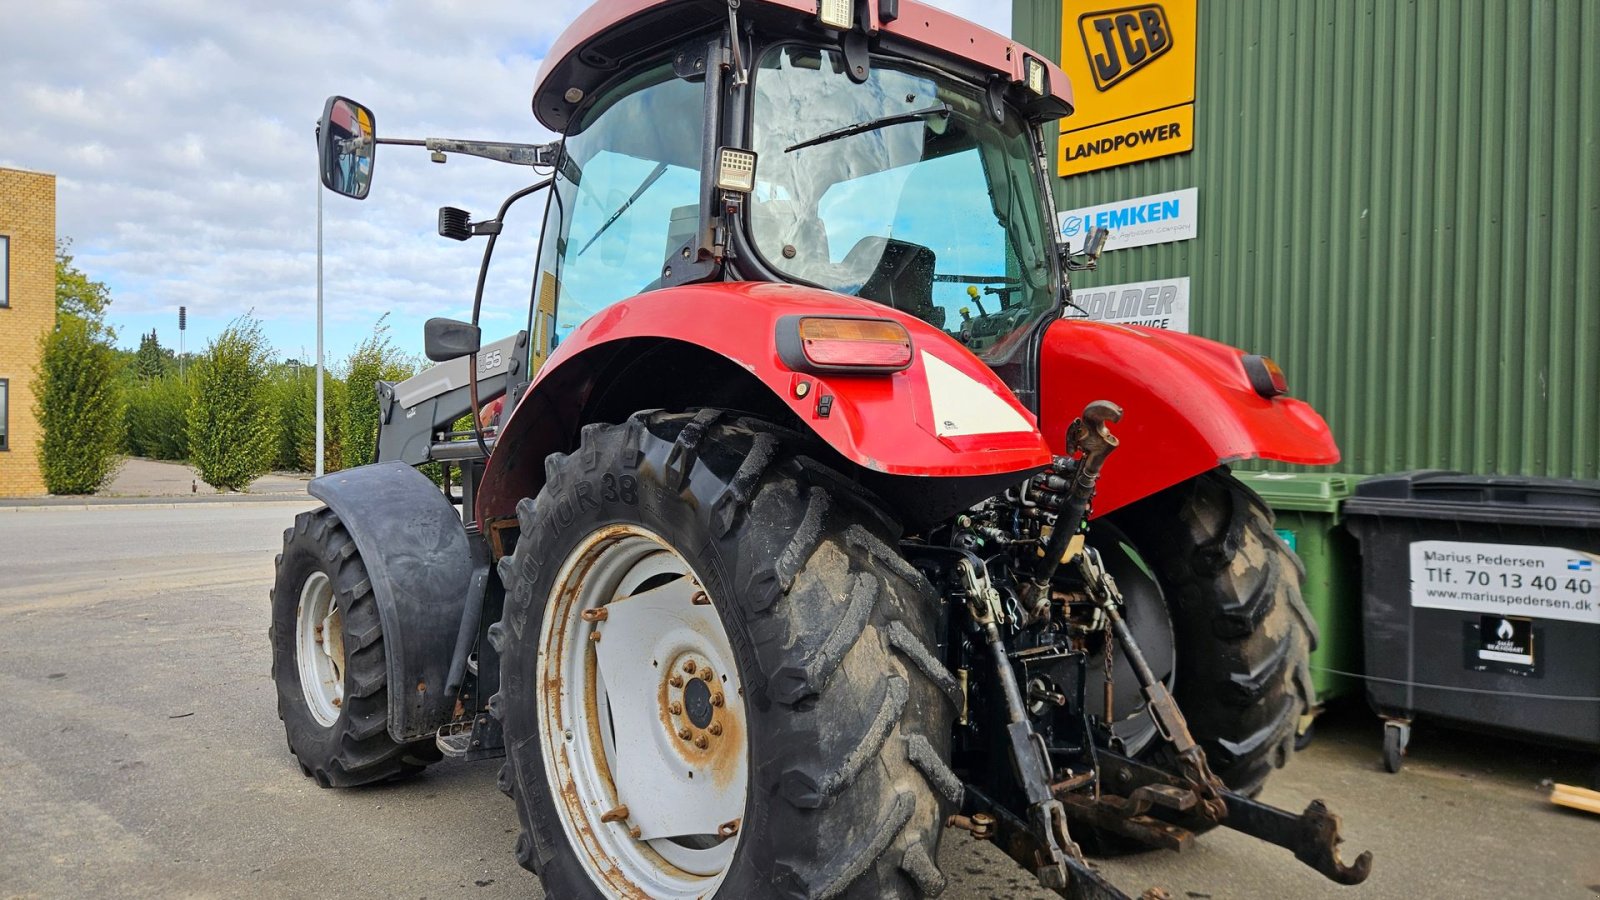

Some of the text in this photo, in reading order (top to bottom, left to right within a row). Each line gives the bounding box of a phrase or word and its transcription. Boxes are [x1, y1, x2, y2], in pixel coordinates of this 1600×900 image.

[1093, 9, 1167, 81] JCB
[1065, 122, 1181, 162] LANDPOWER
[1084, 199, 1180, 233] LEMKEN
[1424, 551, 1545, 568] Marius Pedersen
[1425, 568, 1592, 594] Tlf. 70 13 40 40
[1427, 587, 1592, 611] www.mariuspedersen.dk
